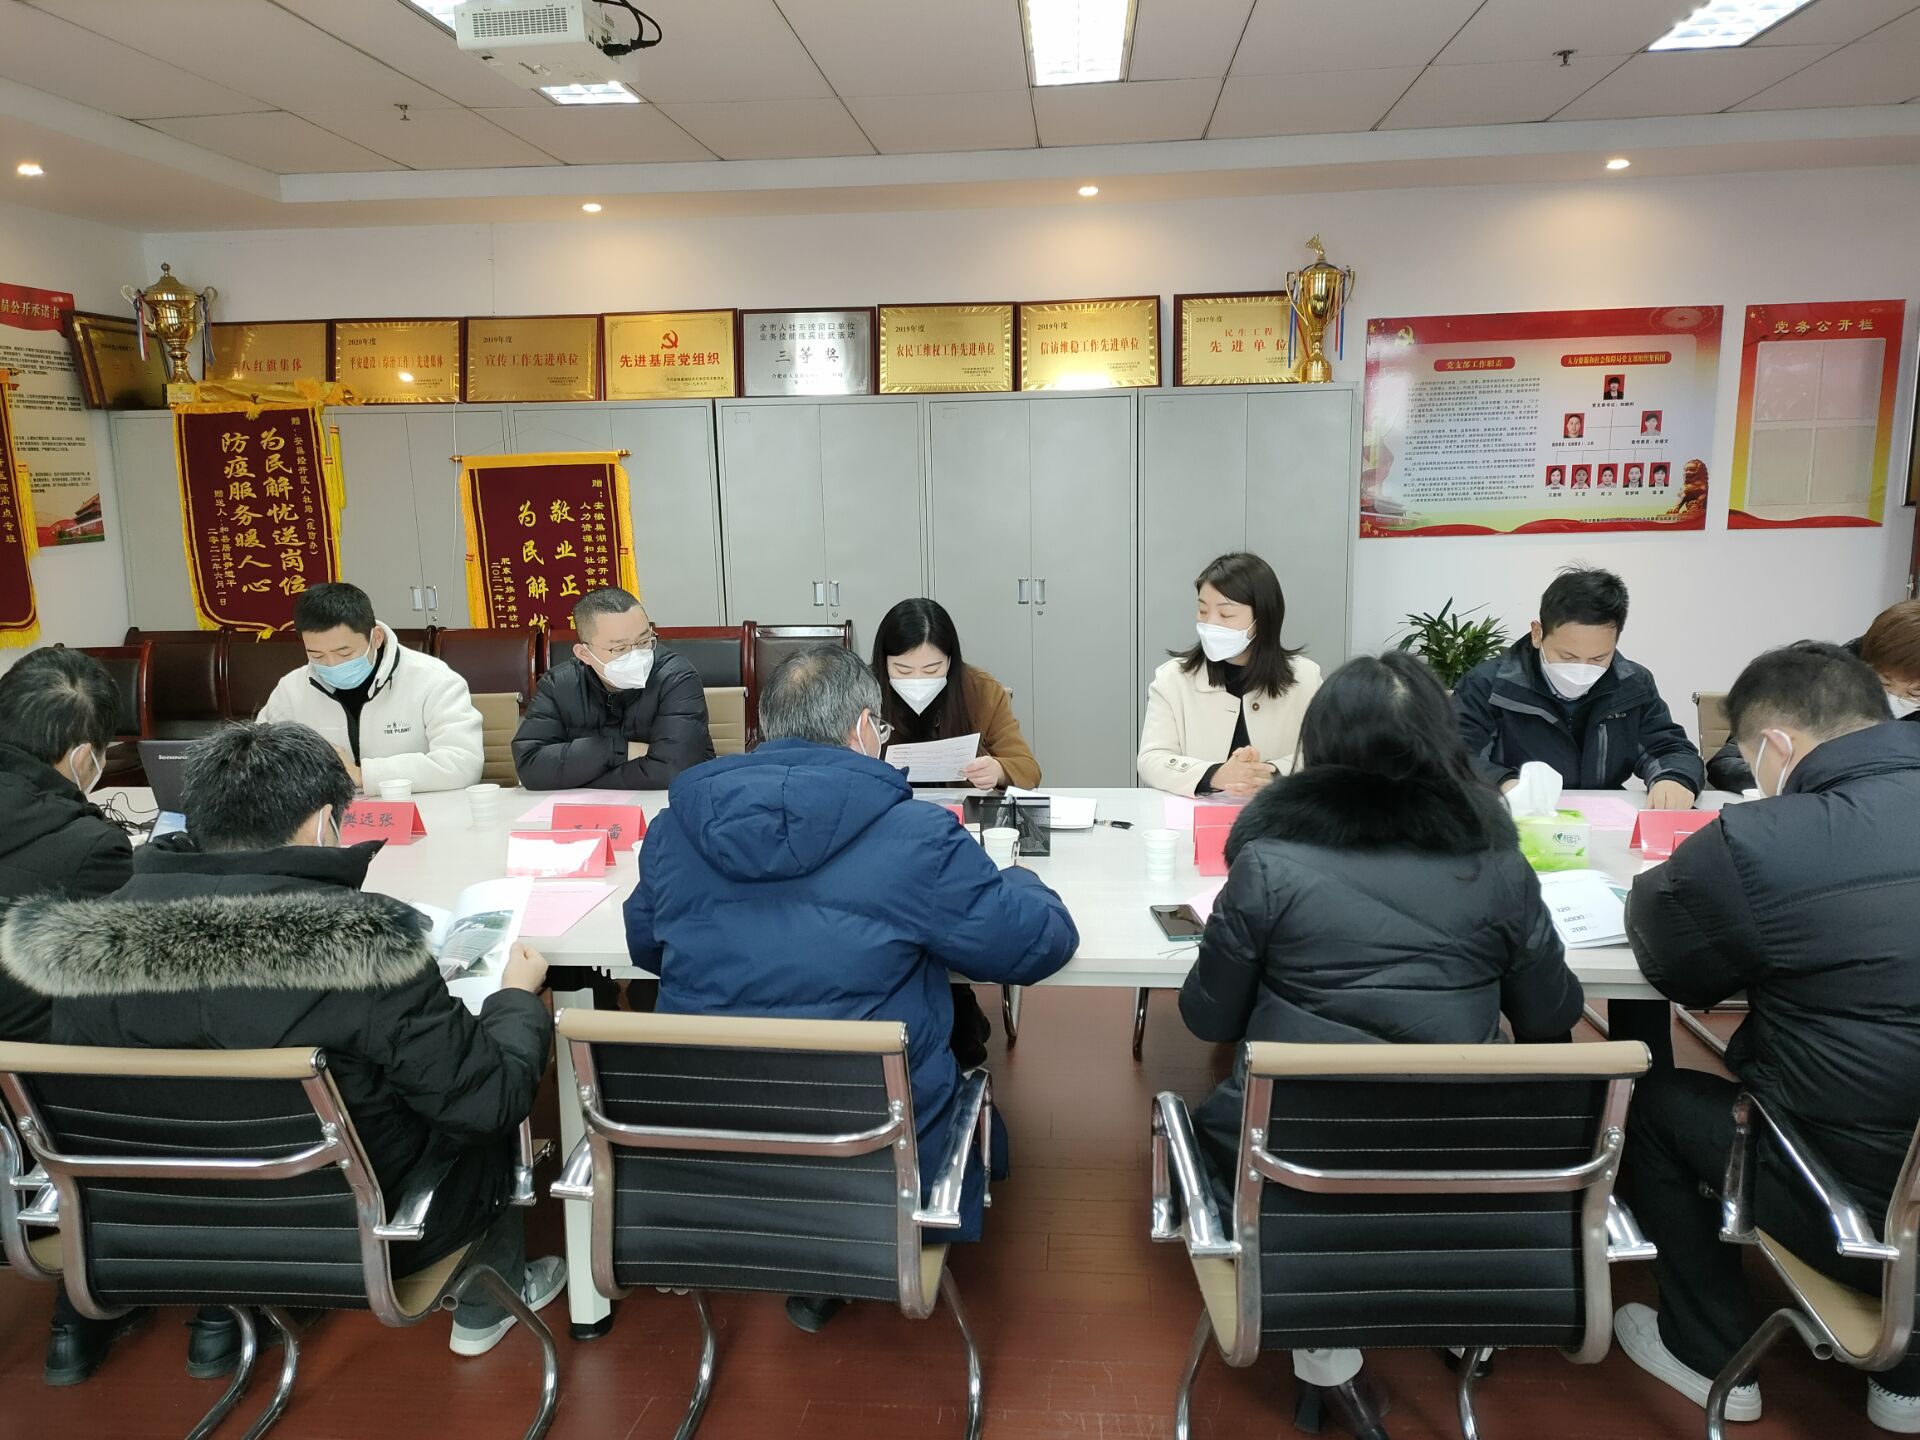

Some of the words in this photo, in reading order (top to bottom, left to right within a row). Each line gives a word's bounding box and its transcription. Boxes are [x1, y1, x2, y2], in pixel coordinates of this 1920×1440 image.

[1, 298, 60, 320] 员公开承诺书
[1037, 321, 1068, 331] 2019年度
[1196, 315, 1222, 323] 2017年度
[1773, 318, 1874, 334] 党务公开栏
[759, 322, 856, 332] 全市人社系统窗口单位
[895, 323, 926, 333] 2019年度
[1225, 327, 1273, 338] 民生工程
[348, 338, 377, 346] 2020年度
[483, 335, 513, 344] 2019年度
[1040, 337, 1140, 356] 信访维稳工作先进单位
[1210, 339, 1288, 353] 先进单位
[775, 346, 839, 364] 三等奖
[896, 341, 996, 358] 农民工维权工作先进单位
[484, 352, 581, 367] 宣传工作先进单位
[619, 351, 721, 368] 先进基层党组织
[220, 432, 273, 594] 防疫服务暖人心
[260, 427, 308, 597] 为民解忧送岗位
[580, 502, 598, 592] 人力资源和社会保
